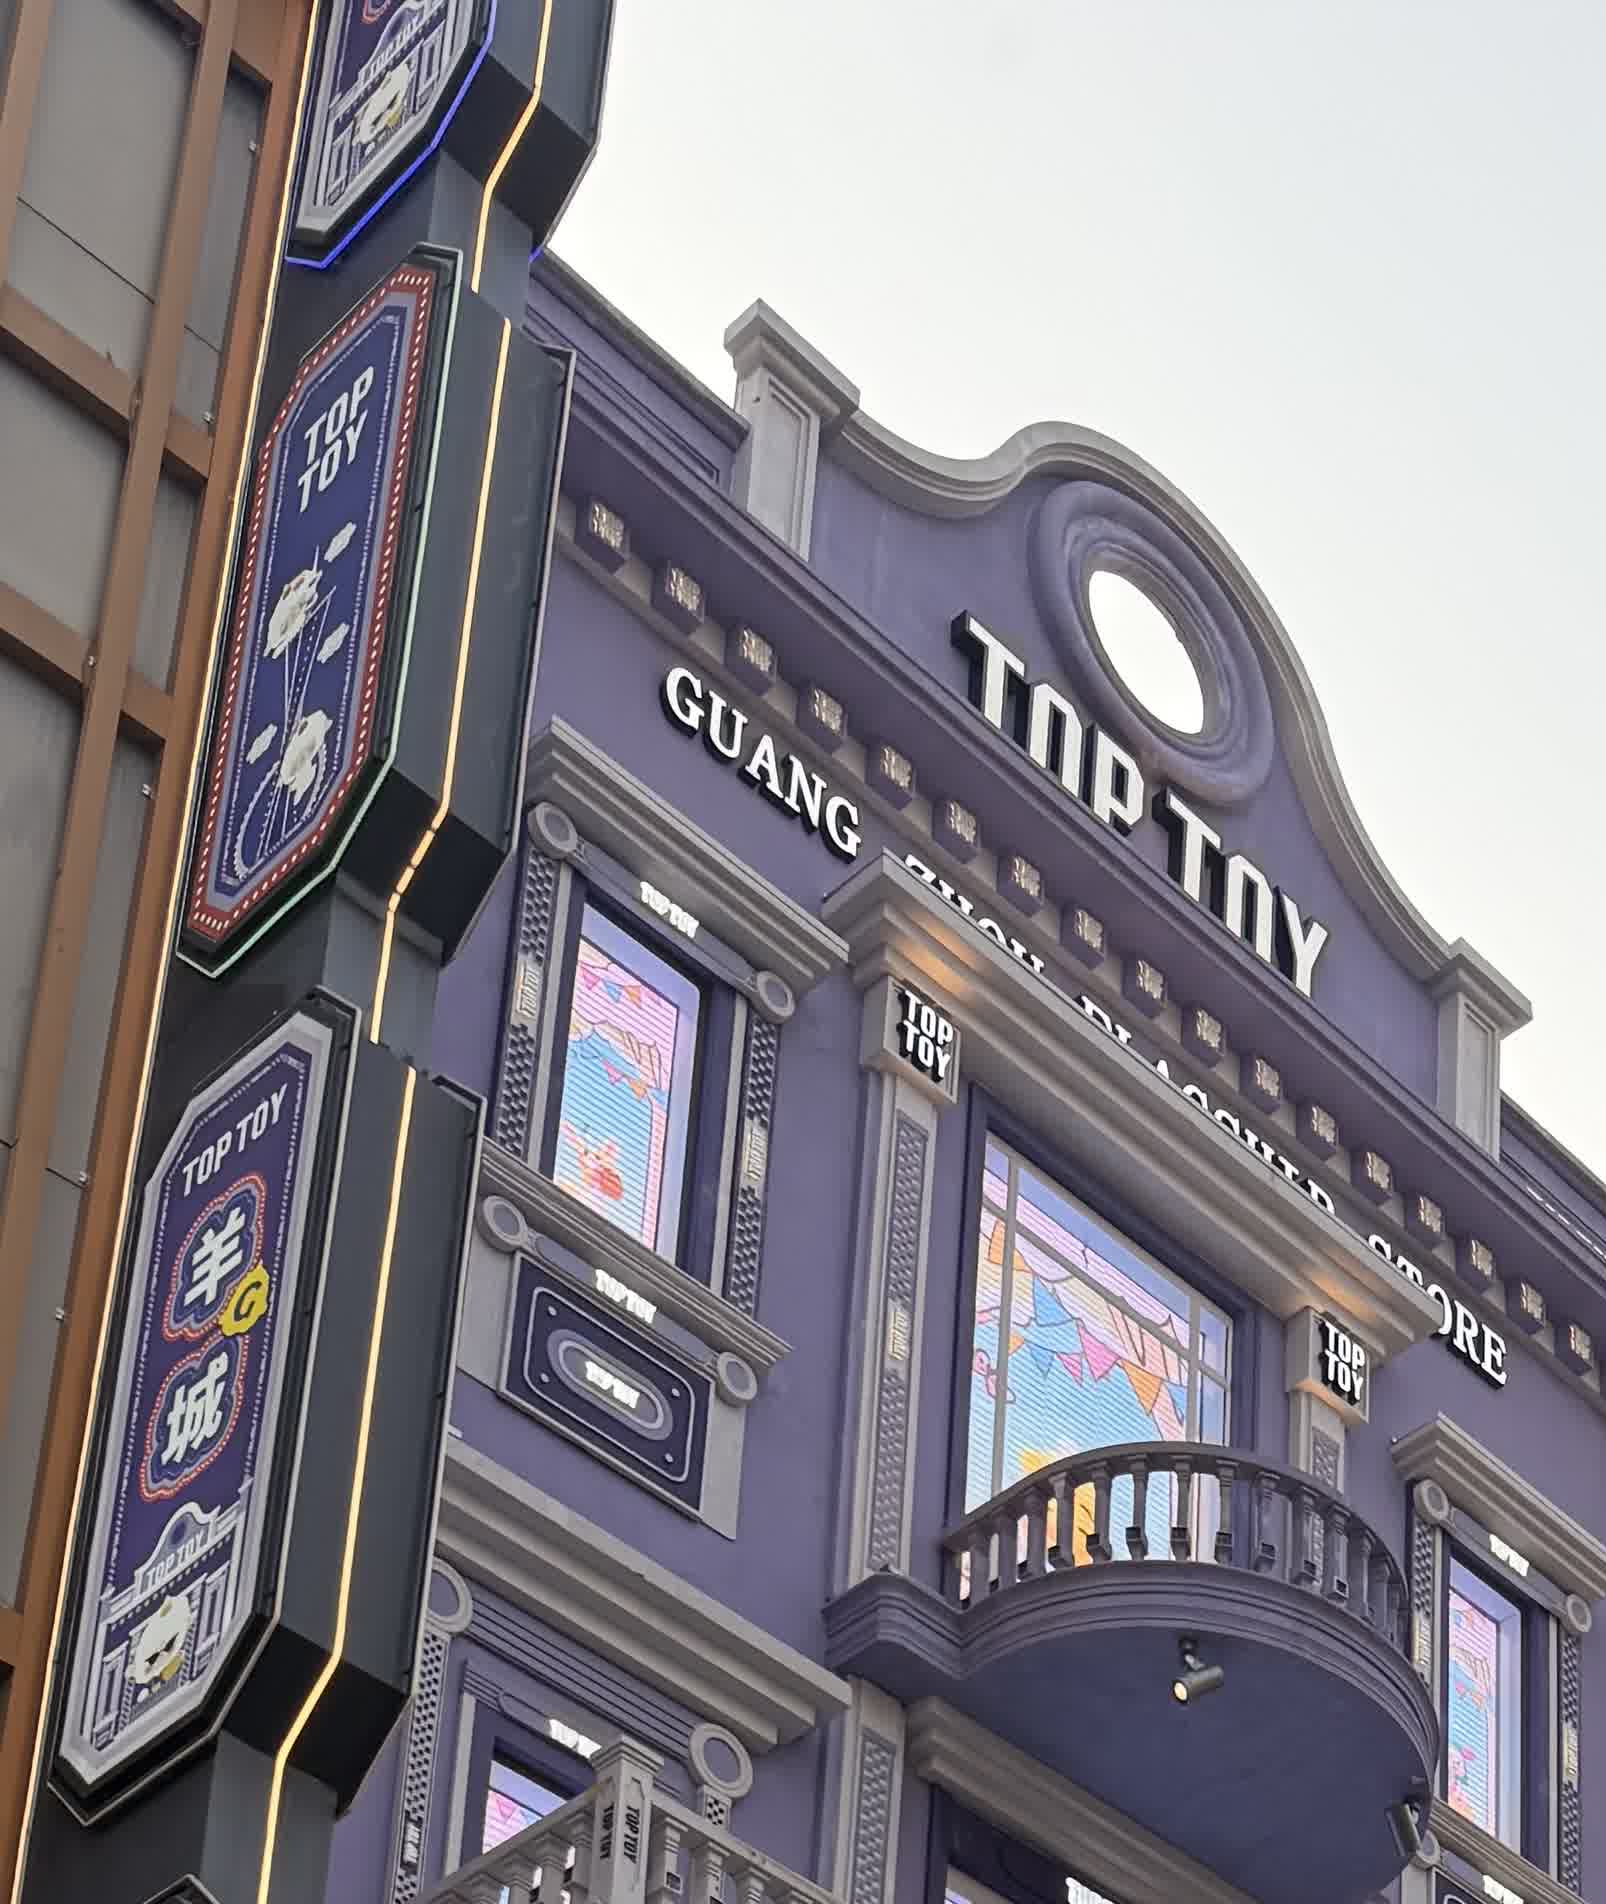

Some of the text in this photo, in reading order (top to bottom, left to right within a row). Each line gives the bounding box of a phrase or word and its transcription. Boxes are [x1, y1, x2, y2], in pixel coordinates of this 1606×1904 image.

[304, 366, 375, 454] TOP
[297, 413, 368, 513] TOY
[665, 667, 861, 854] GUANG
[963, 617, 1145, 832] TOP
[1164, 793, 1331, 996] TOY
[902, 1019, 951, 1079] TOY
[904, 990, 953, 1048] TOP
[183, 1084, 288, 1196] TOP TOY
[162, 1207, 244, 1463] 羊城
[1323, 1350, 1364, 1400] TOY
[1325, 1322, 1365, 1368] TOP
[623, 1804, 640, 1864] TOP TOY
